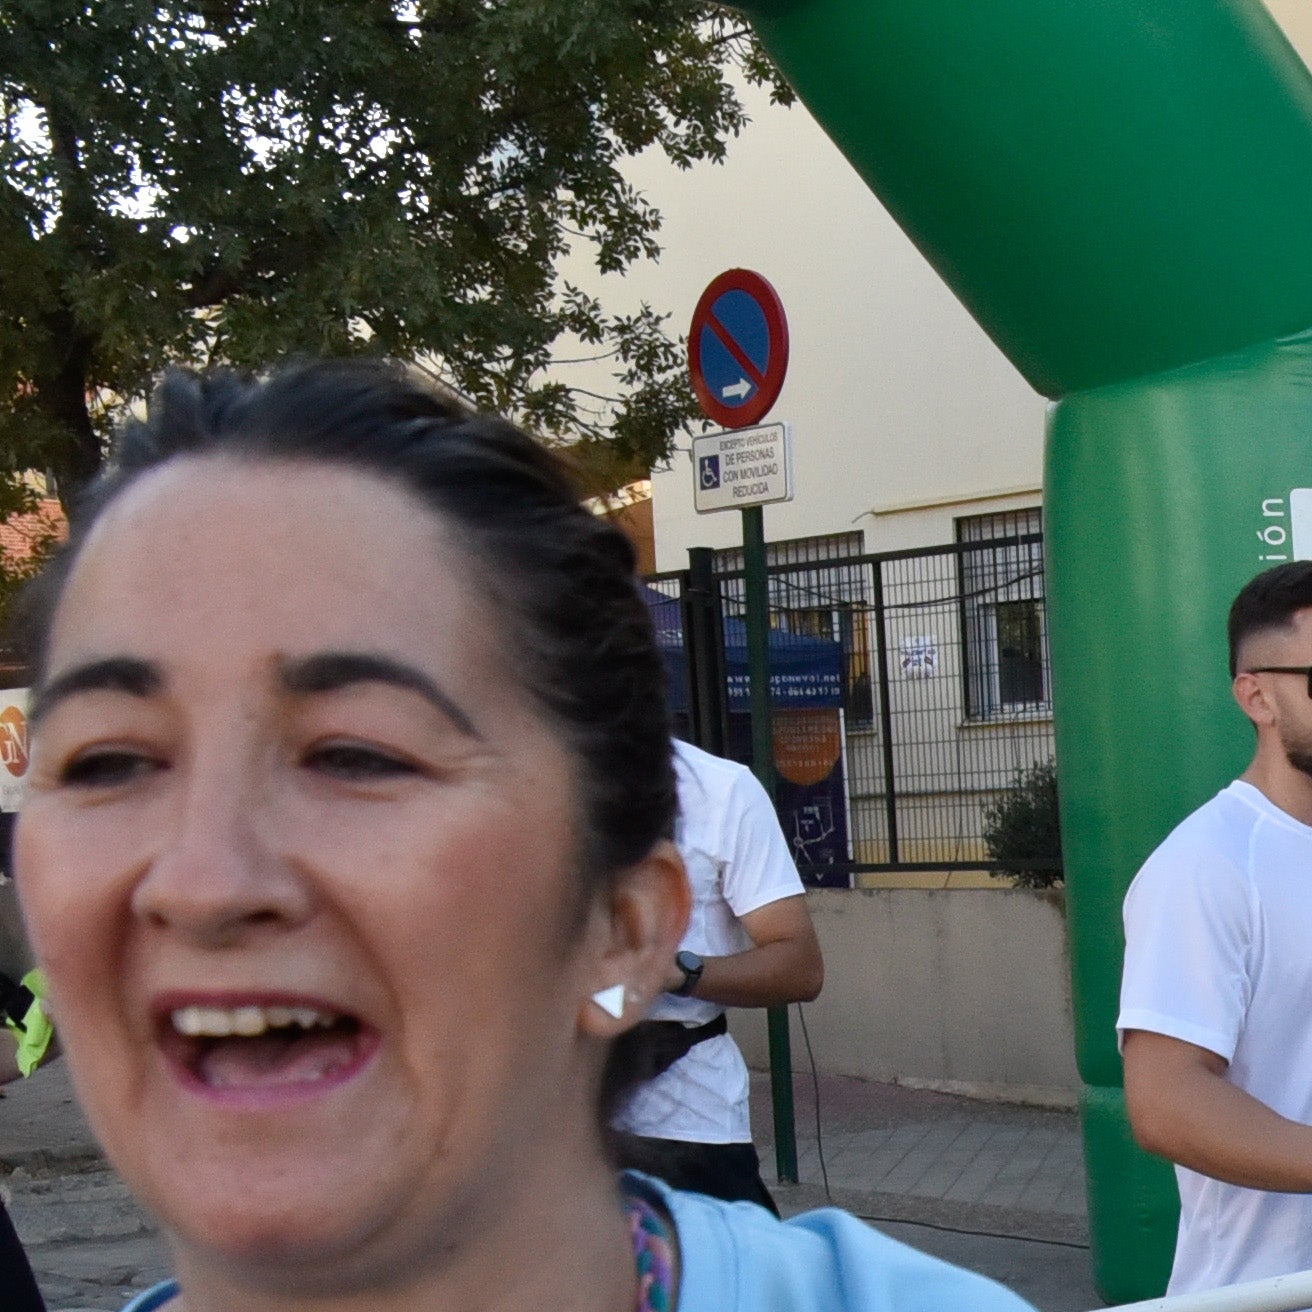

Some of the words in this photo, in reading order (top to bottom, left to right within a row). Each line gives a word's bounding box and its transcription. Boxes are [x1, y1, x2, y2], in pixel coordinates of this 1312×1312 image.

[736, 446, 775, 463] PERSONAS
[723, 468, 738, 483] CON
[733, 481, 769, 498] REDUCIDA
